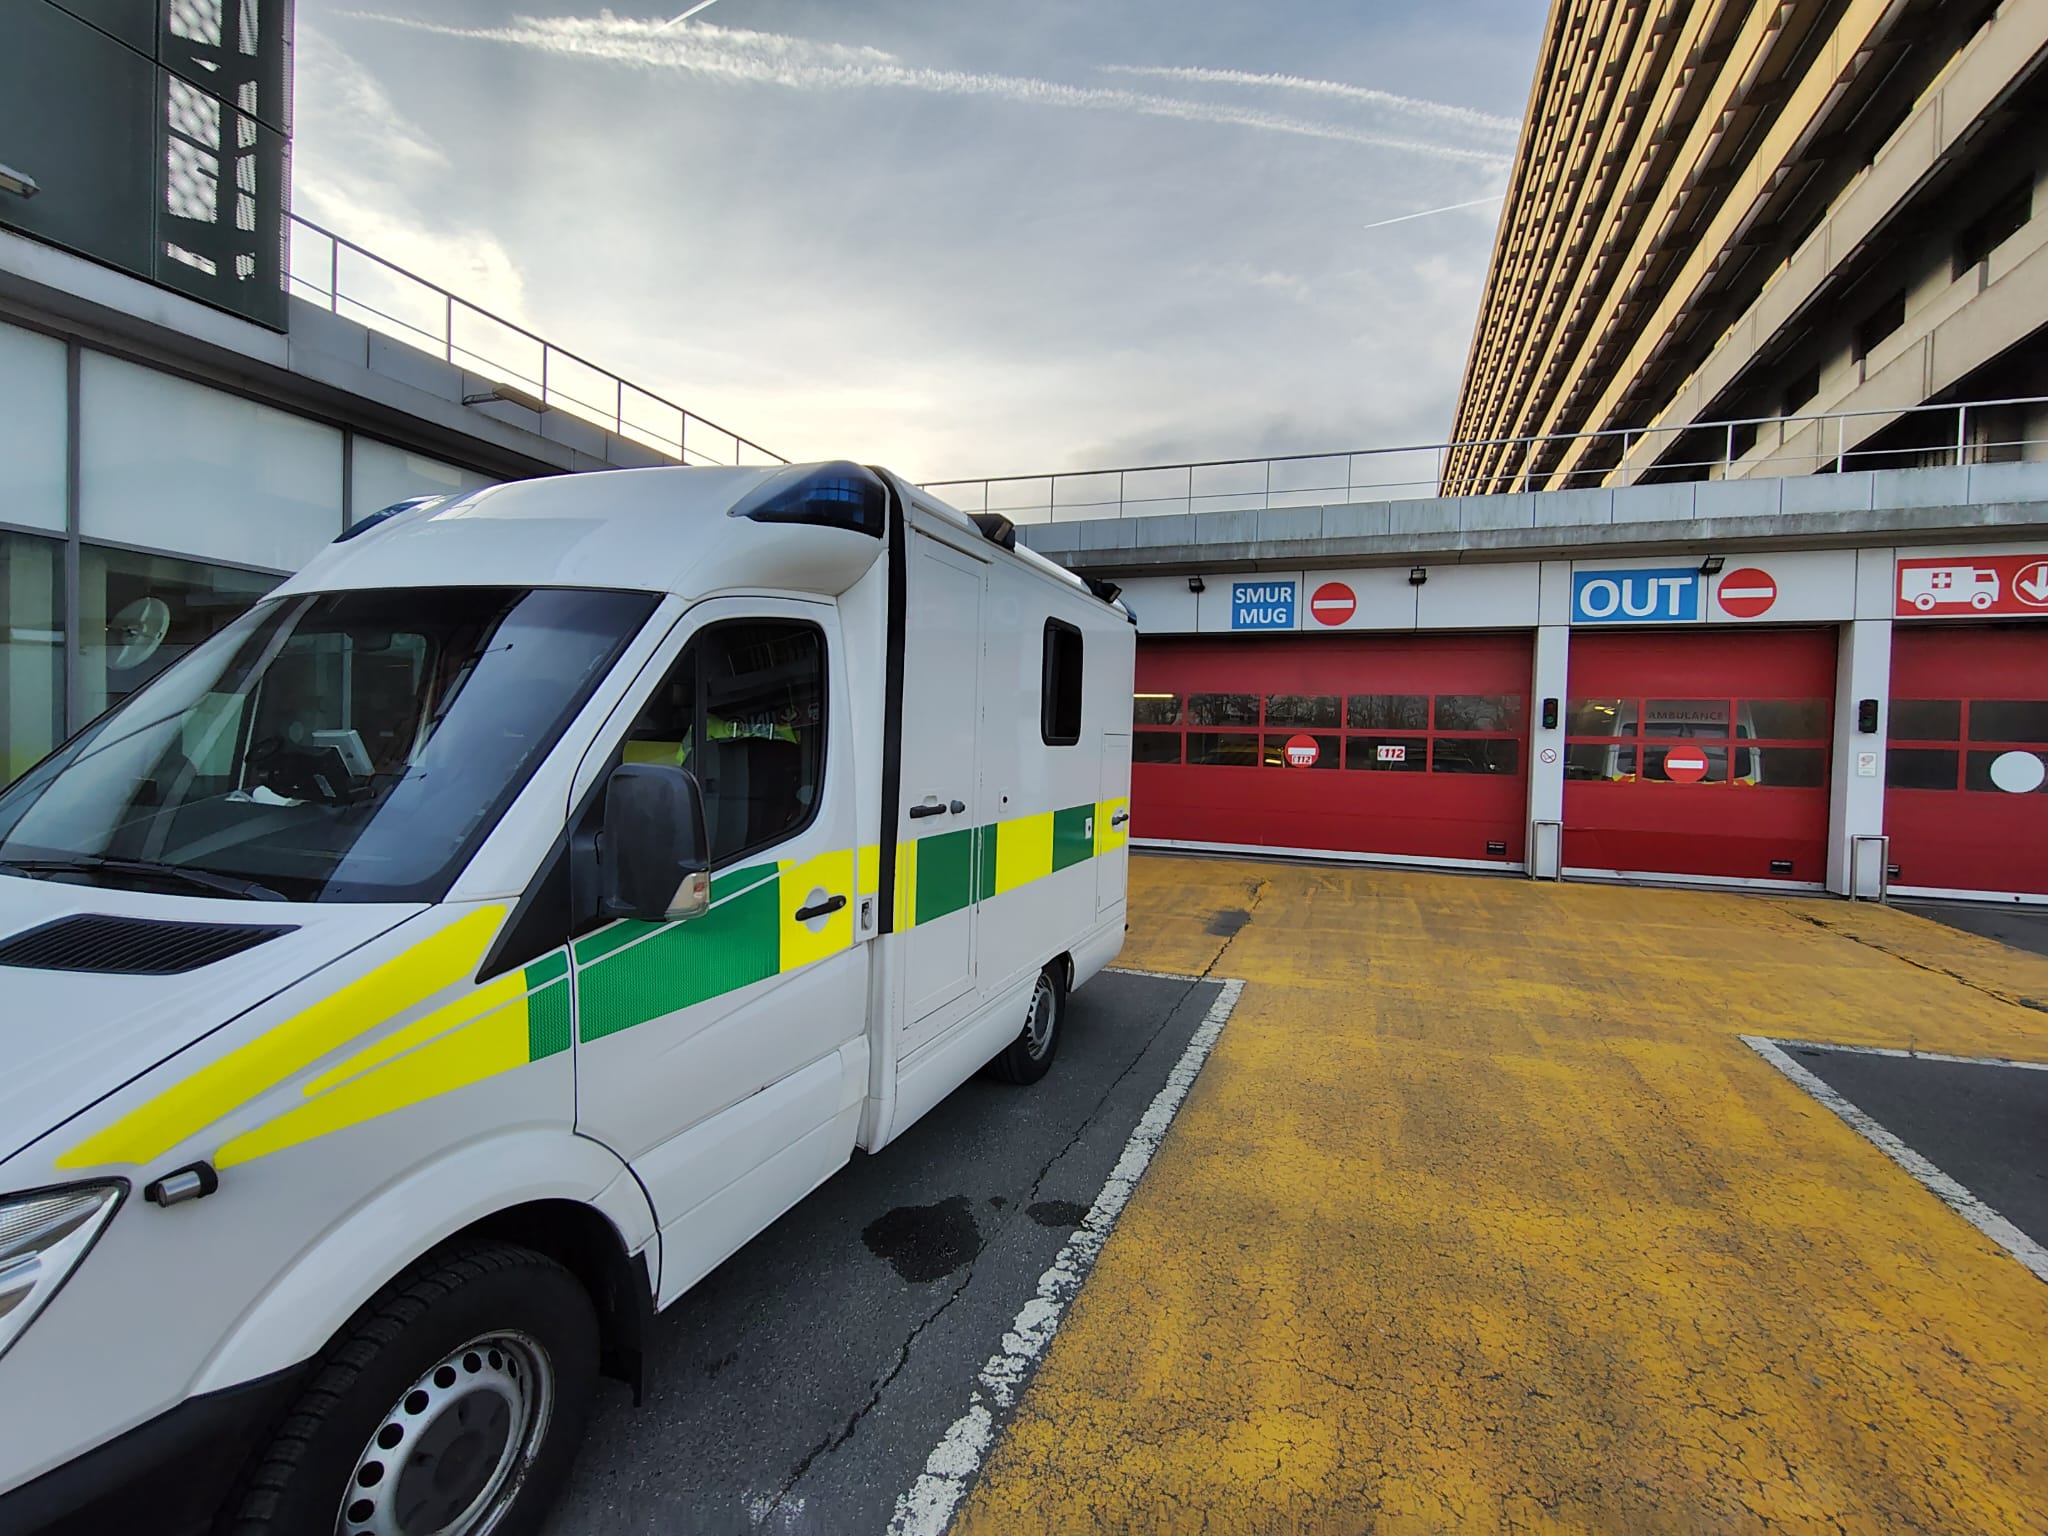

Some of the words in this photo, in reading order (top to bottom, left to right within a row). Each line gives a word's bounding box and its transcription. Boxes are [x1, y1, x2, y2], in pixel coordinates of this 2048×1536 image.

[1235, 587, 1292, 604] SMUR
[1580, 577, 1693, 618] OUT
[1239, 607, 1287, 624] MUG
[1648, 711, 1724, 721] AMBULANCE
[1384, 748, 1404, 759] 112
